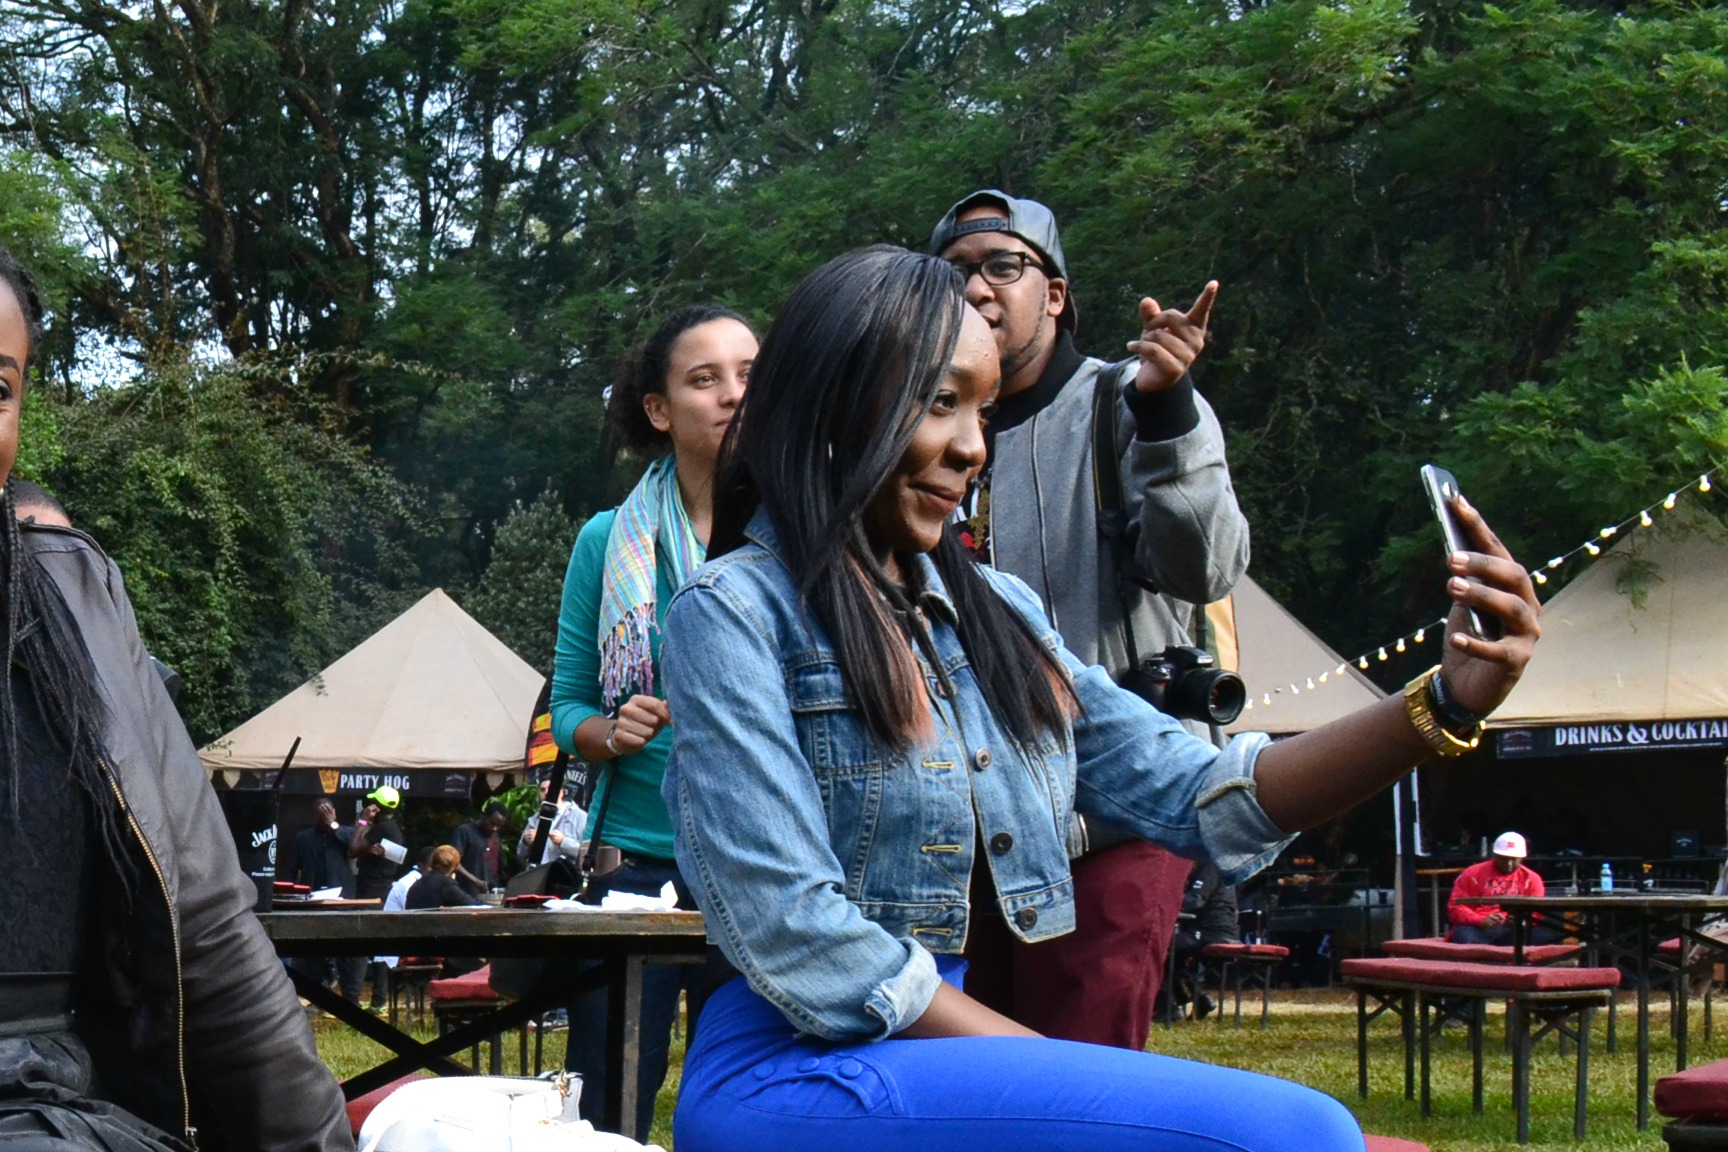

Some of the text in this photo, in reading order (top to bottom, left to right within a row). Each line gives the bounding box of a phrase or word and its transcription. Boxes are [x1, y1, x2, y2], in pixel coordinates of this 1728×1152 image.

[1555, 724, 1623, 746] DRINKS
[1626, 723, 1650, 744] &
[340, 774, 410, 790] PARTY HOG
